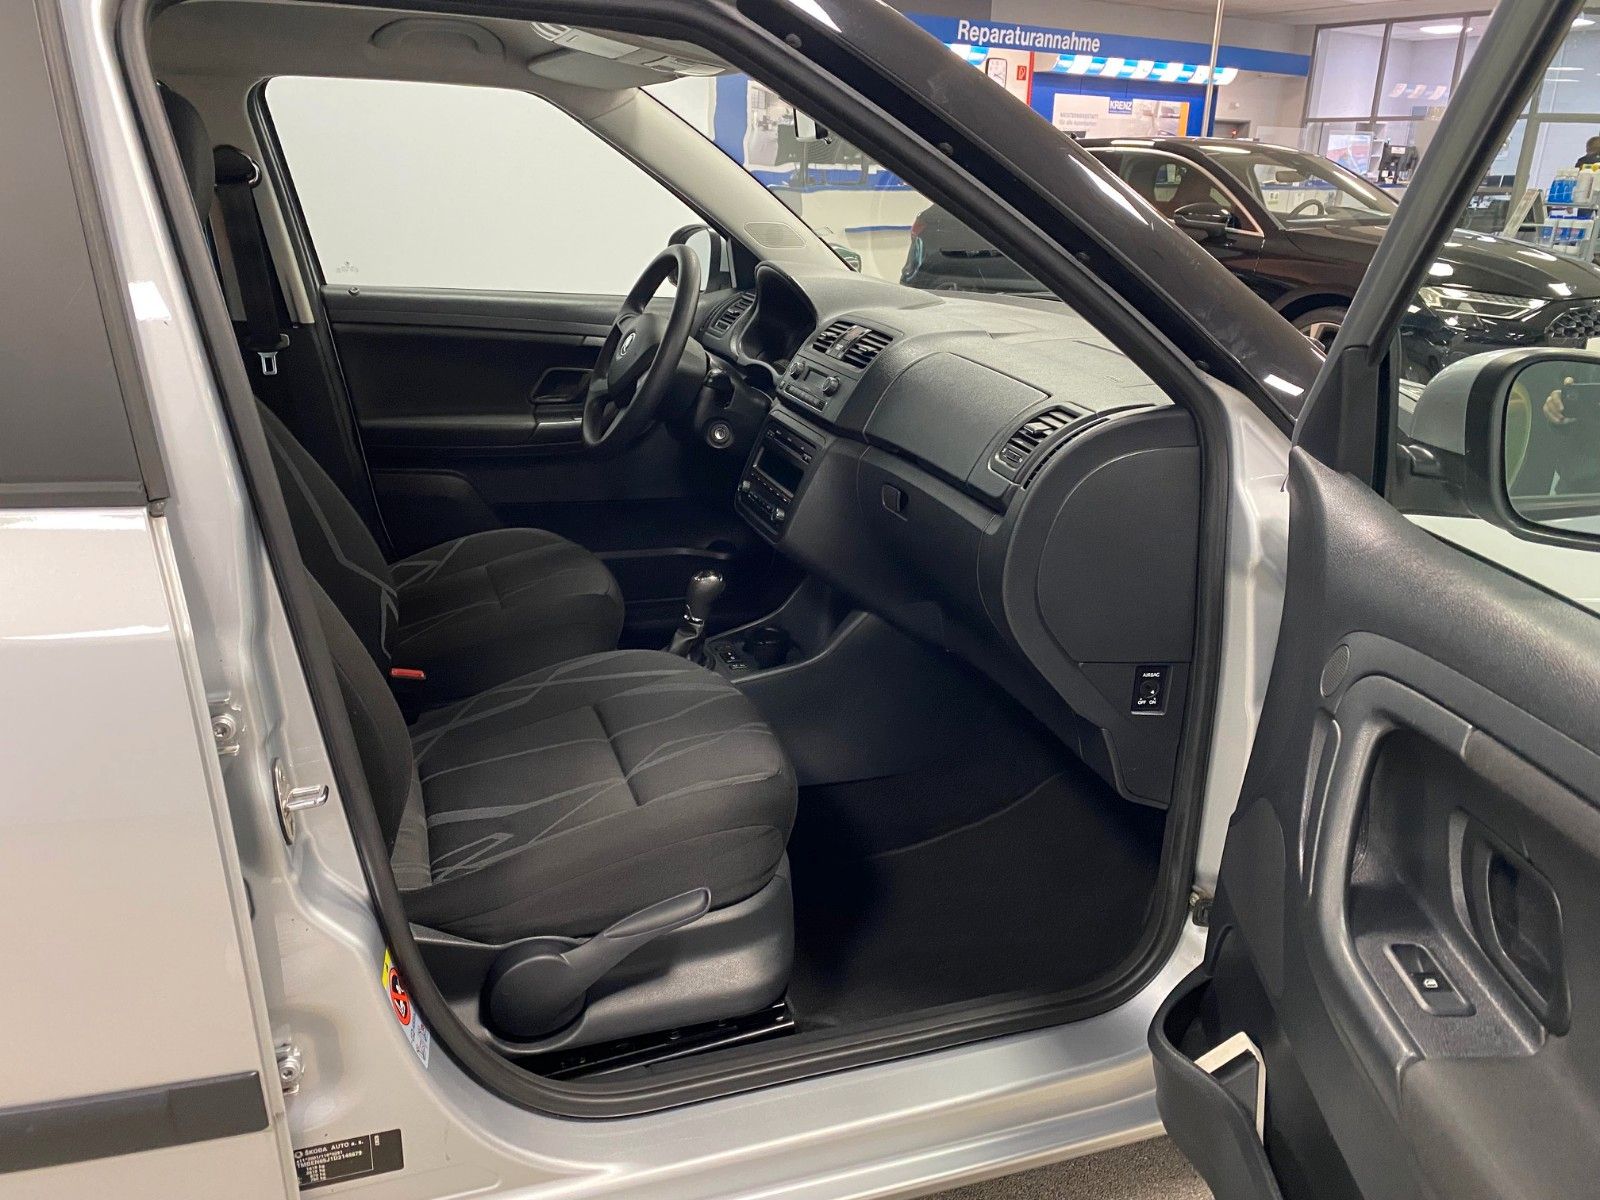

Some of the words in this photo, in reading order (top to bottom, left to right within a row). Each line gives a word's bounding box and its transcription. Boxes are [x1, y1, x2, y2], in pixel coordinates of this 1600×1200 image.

[957, 19, 1100, 52] Reparaturannahme
[1109, 100, 1133, 111] KRENZ
[304, 1146, 328, 1156] ŠKODA
[331, 1142, 349, 1150] AUTO
